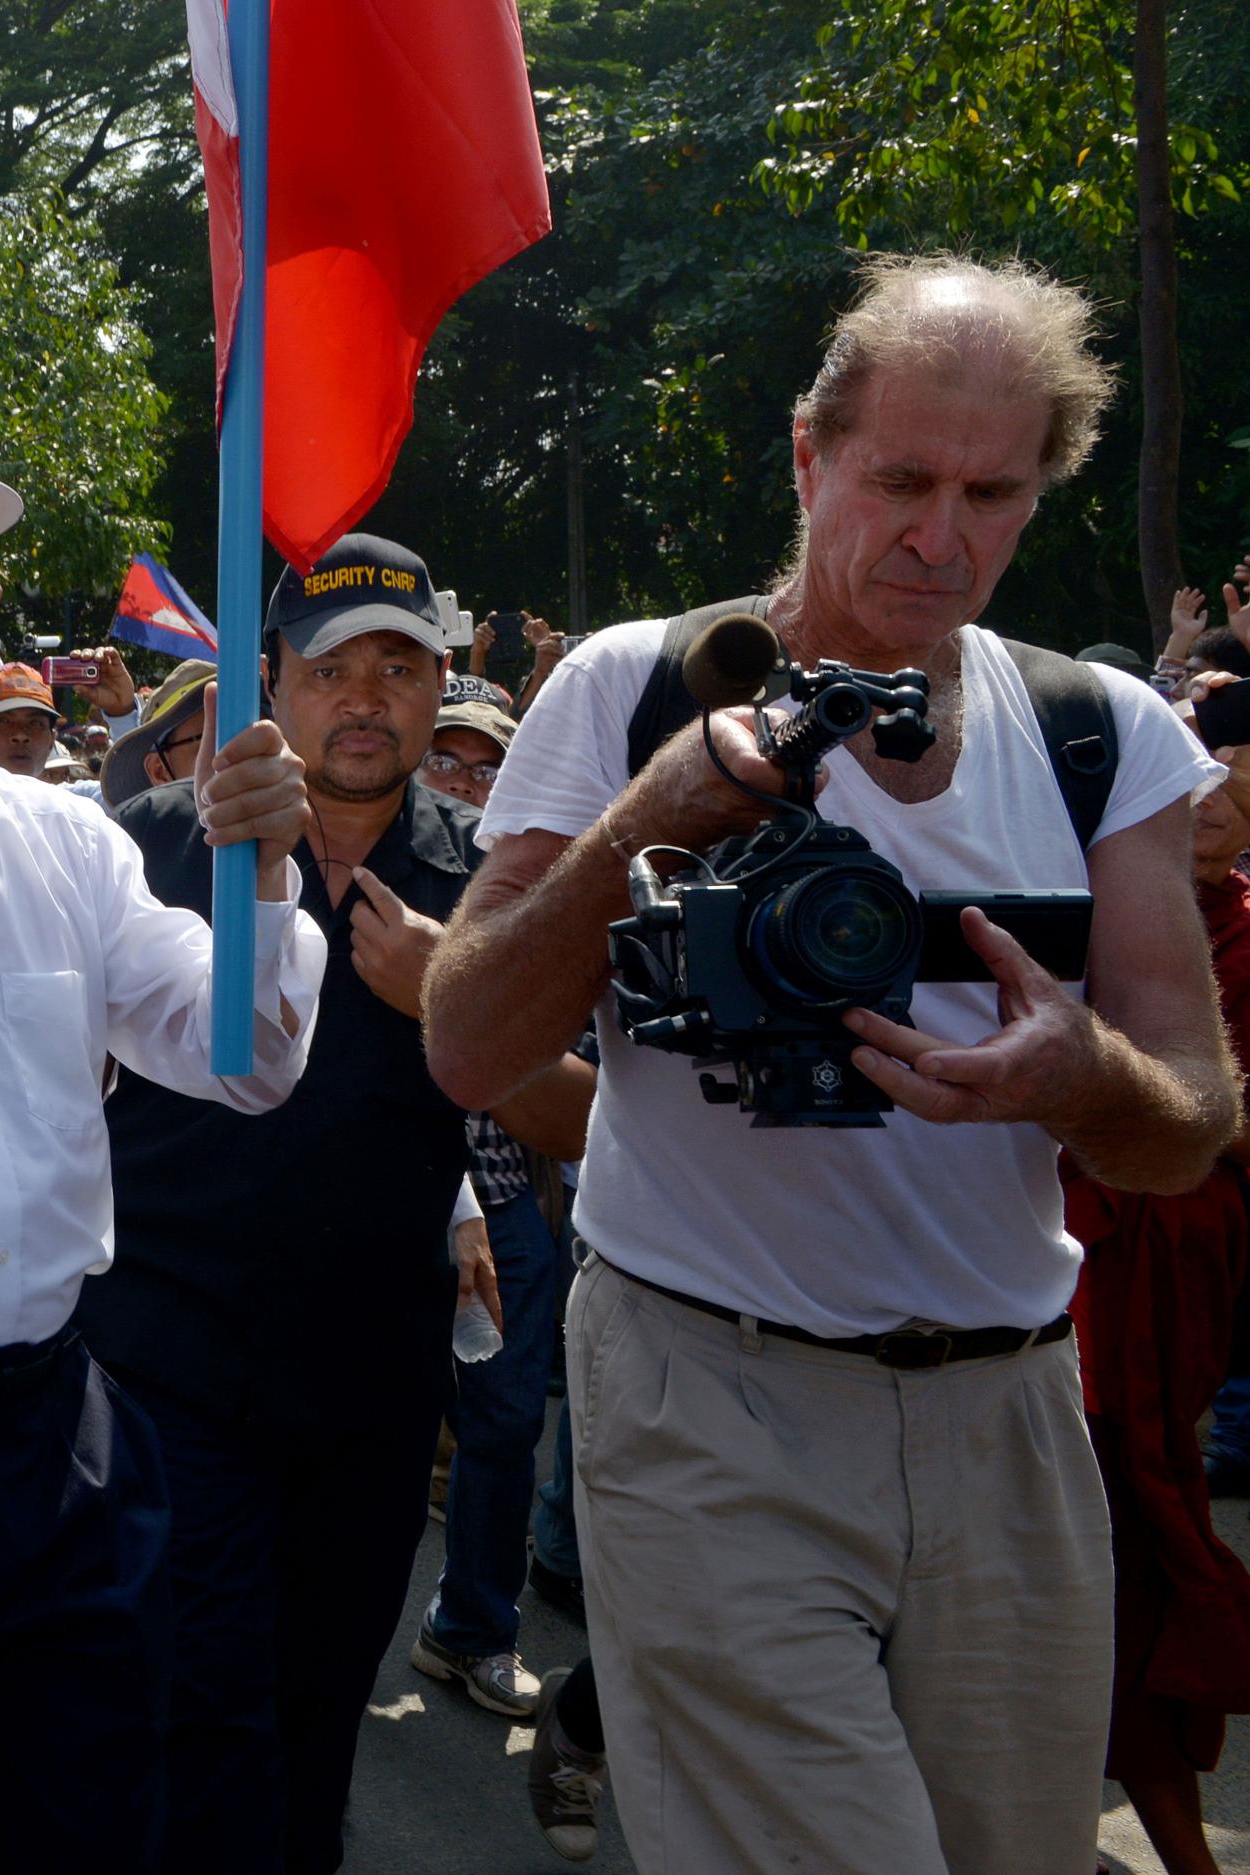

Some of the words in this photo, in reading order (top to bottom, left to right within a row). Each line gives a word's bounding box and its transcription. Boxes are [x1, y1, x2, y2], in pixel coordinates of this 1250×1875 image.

[304, 566, 375, 596] SECURITY
[381, 568, 415, 592] CNRP
[443, 678, 497, 700] DEA
